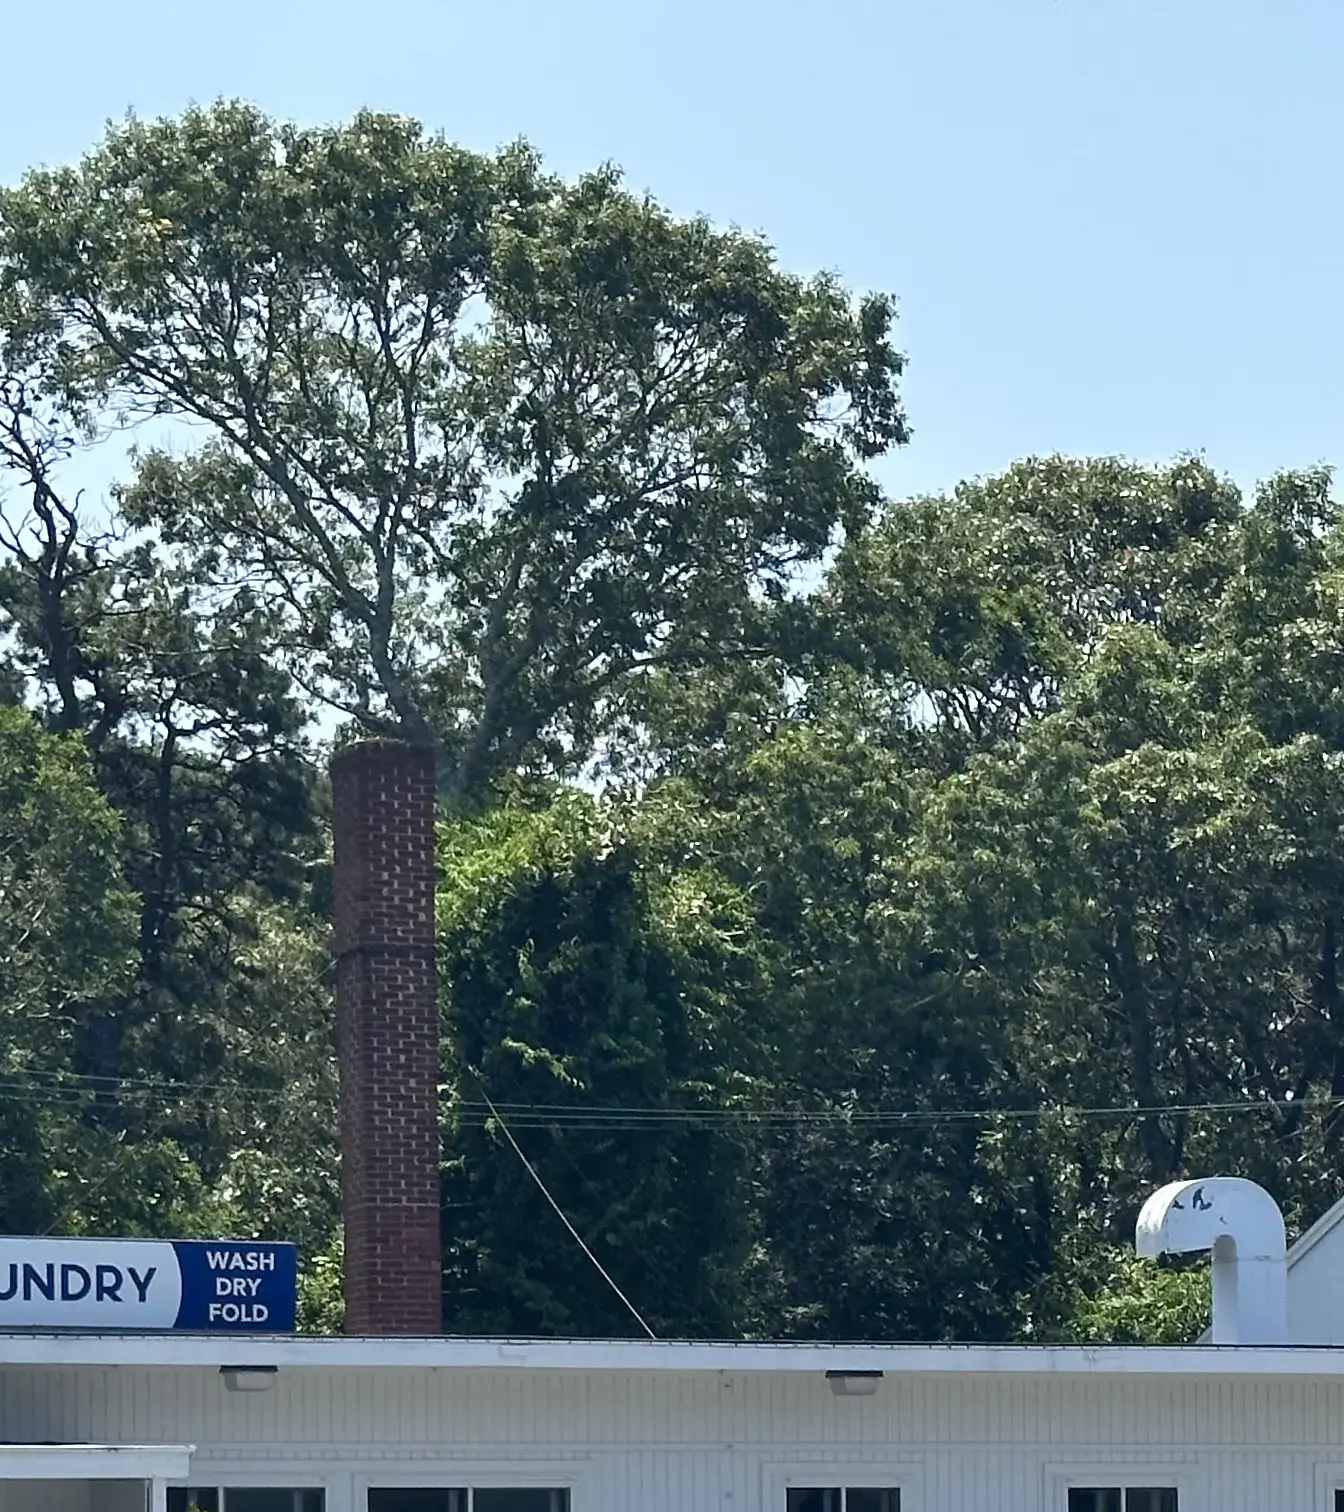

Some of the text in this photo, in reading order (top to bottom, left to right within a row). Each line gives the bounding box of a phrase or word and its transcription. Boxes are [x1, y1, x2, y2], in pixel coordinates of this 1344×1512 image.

[206, 1251, 276, 1272] WASH
[216, 1277, 262, 1297] DRY
[208, 1302, 269, 1324] FOLD
